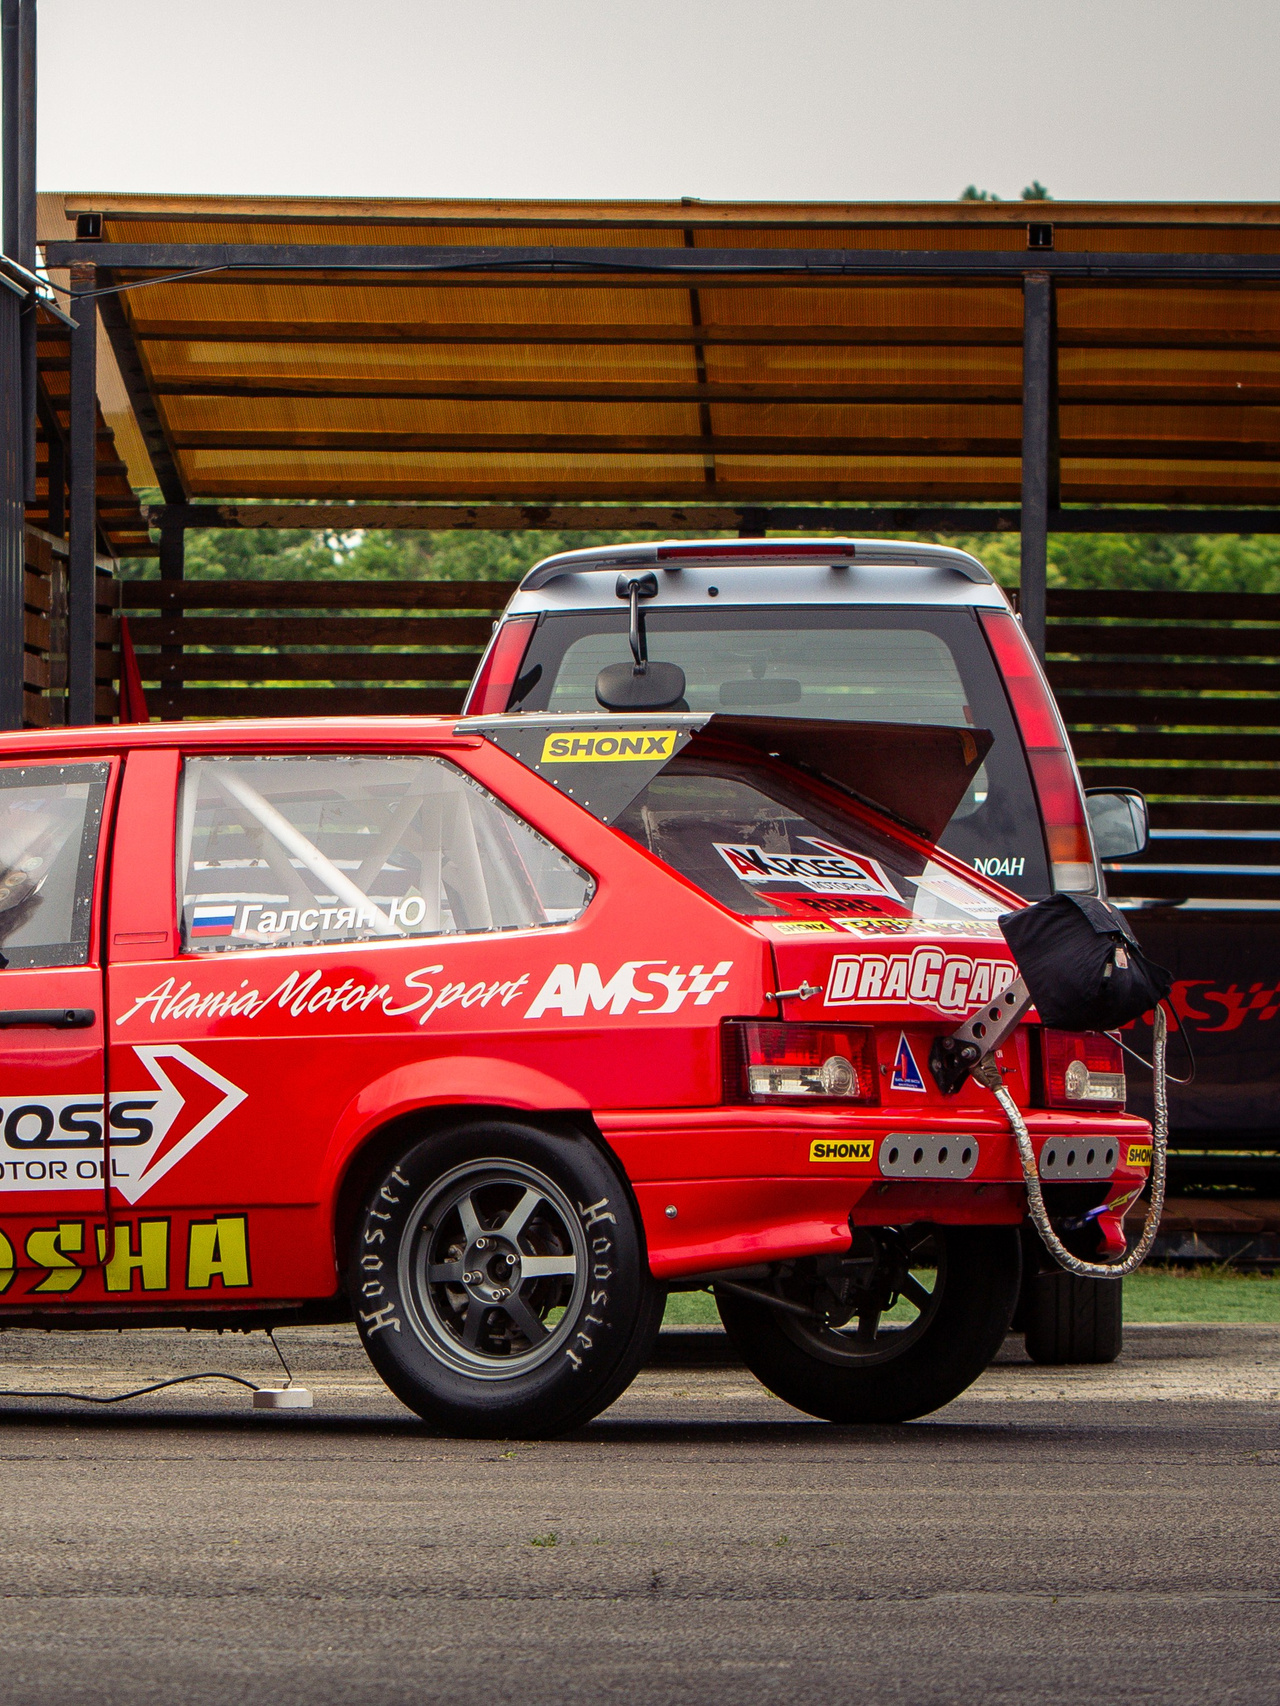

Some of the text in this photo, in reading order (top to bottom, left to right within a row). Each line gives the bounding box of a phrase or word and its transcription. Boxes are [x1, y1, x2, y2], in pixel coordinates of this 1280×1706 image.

[548, 735, 669, 757] SHONX
[974, 857, 1025, 876] NOAH
[239, 896, 426, 934] Галстян Ю
[830, 950, 1020, 1008] DRAGGAR
[116, 976, 263, 1025] Alania
[251, 969, 391, 1019] Motor
[382, 964, 530, 1025] Sport
[813, 1143, 871, 1158] SHONX
[1129, 1148, 1152, 1163] SHON
[76, 1158, 130, 1179] OIL
